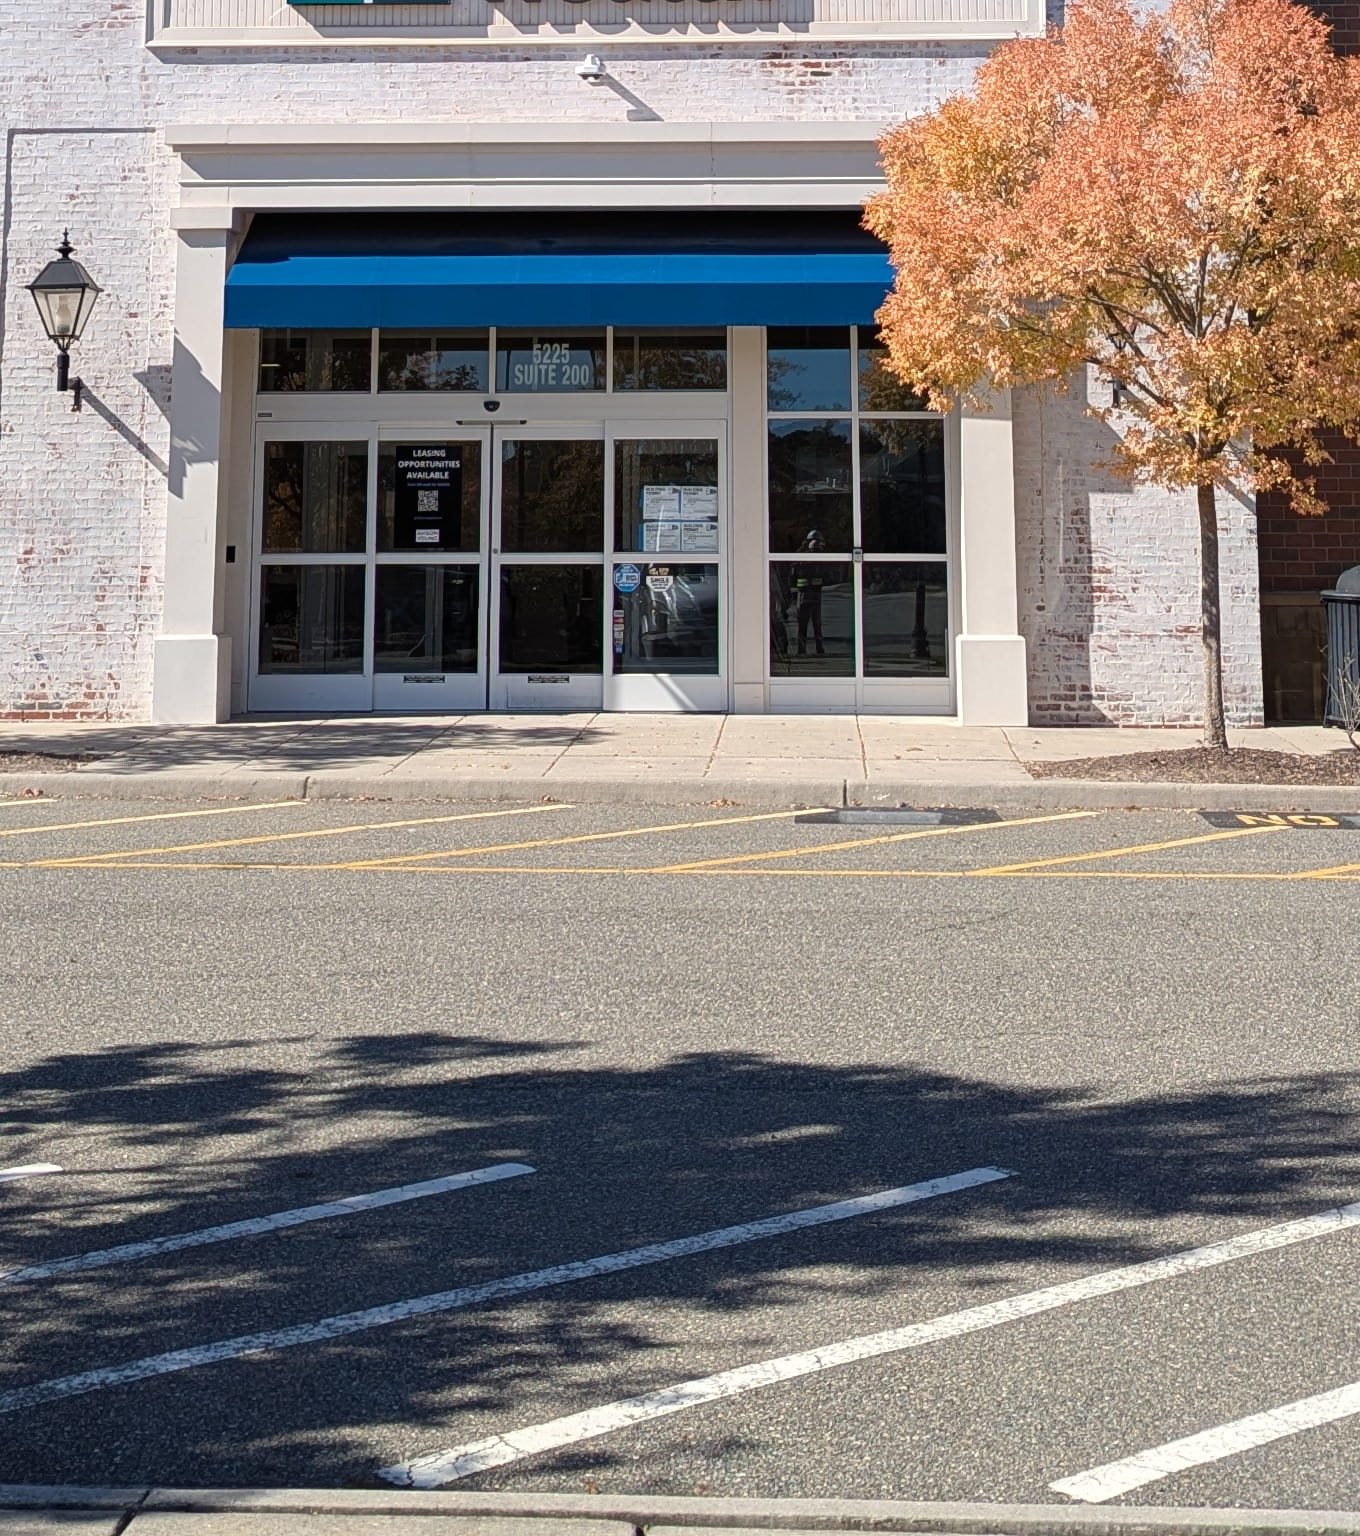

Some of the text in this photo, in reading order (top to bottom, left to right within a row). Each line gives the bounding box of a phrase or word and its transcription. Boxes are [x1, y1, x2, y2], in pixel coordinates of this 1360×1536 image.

[532, 343, 570, 364] 5225
[514, 364, 590, 385] SUITE 200
[412, 449, 446, 457] LEASING
[398, 460, 461, 468] OPPORTUNITIES
[406, 471, 450, 479] AVAILABLE
[1236, 814, 1340, 826] NO
